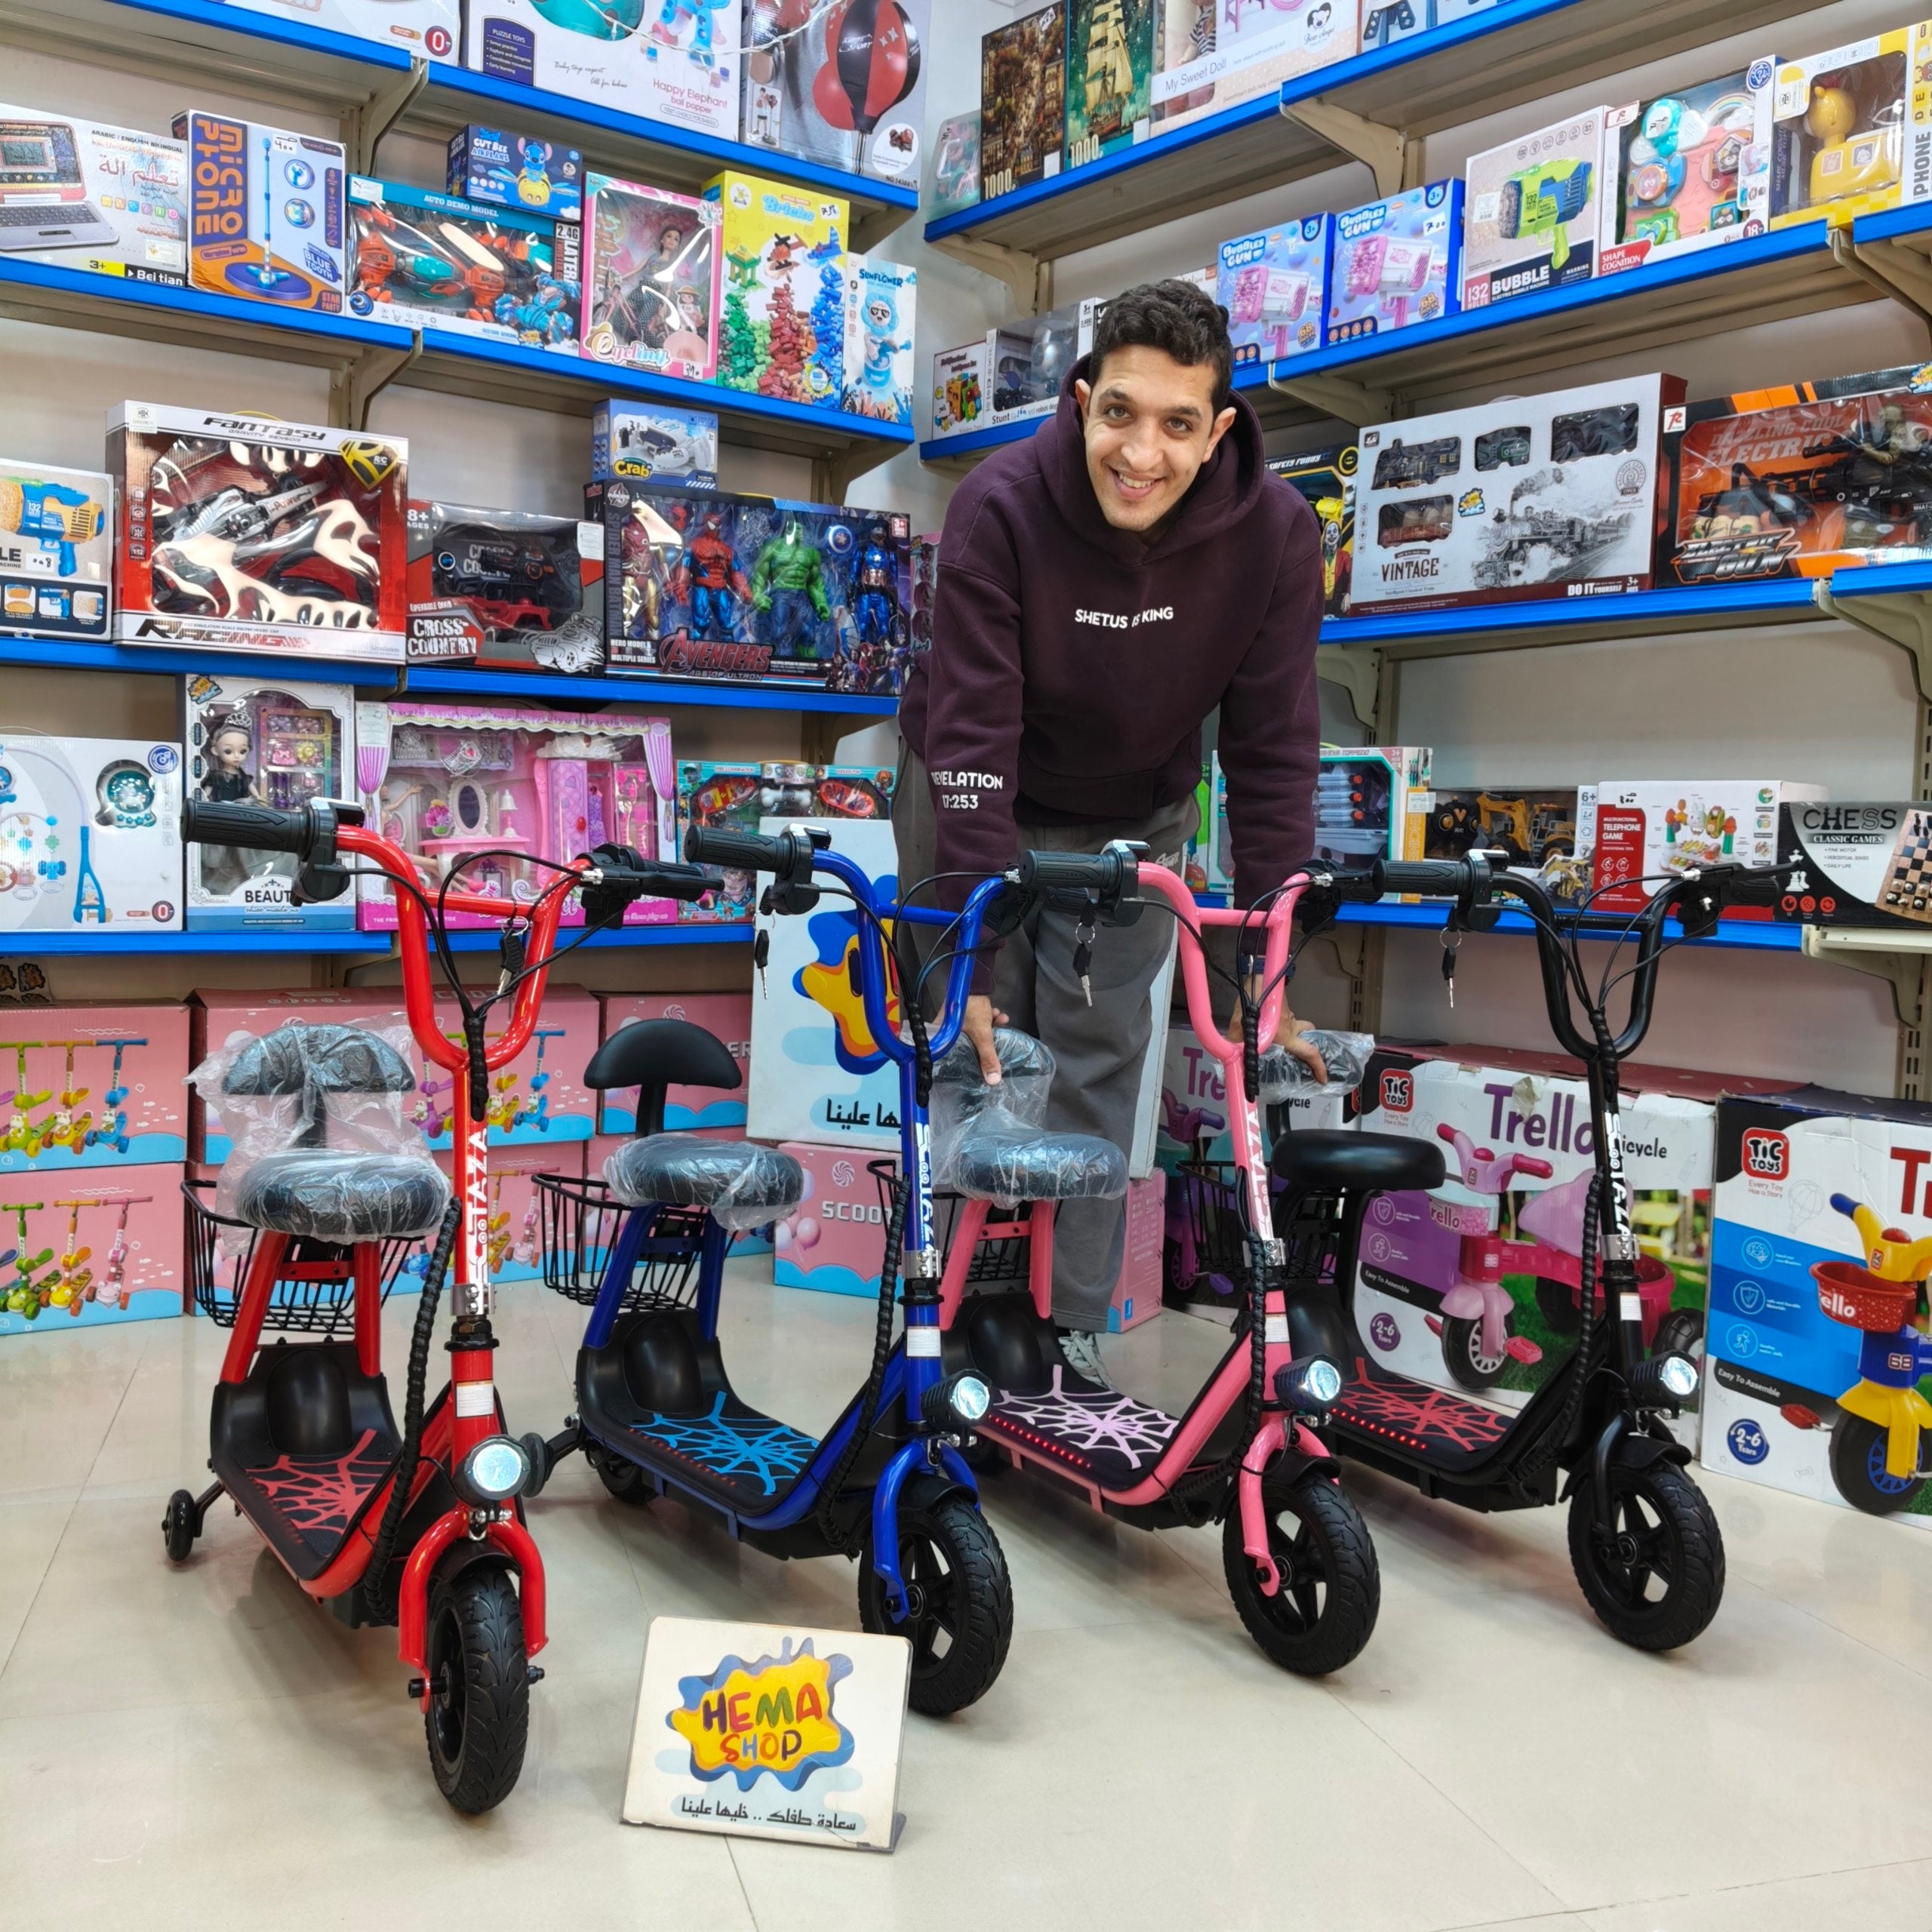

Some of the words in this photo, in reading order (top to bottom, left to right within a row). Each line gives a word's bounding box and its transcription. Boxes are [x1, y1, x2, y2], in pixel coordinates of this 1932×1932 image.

[493, 29, 510, 40] PUZZLE
[512, 34, 526, 43] TOYS
[1165, 78, 1179, 93] My
[1180, 66, 1208, 87] Sweet
[1210, 58, 1227, 75] Doll
[653, 78, 685, 100] Happy
[687, 88, 728, 109] Elephant
[671, 96, 683, 107] ball
[686, 101, 712, 115] popper
[91, 129, 115, 139] ARABIC
[121, 135, 149, 146] ENGLISH
[150, 141, 183, 153] BILINGUAL
[473, 137, 492, 149] CUT
[493, 141, 508, 153] BEE
[471, 147, 510, 163] AIRPLANE
[1913, 131, 1931, 196] PHONE
[423, 194, 445, 206] AUTO
[445, 196, 470, 211] DEMO
[471, 204, 500, 218] MODEL
[1430, 192, 1441, 202] 3+
[1526, 193, 1537, 204] 132
[1340, 207, 1386, 229] BUBBLES
[556, 225, 580, 240] 2.4G
[1306, 225, 1316, 234] 3+
[1345, 221, 1371, 238] GUN
[1223, 238, 1265, 257] BUBBLES
[1601, 249, 1626, 263] SHAPE
[90, 260, 106, 269] 3+
[304, 249, 332, 272] BLUE
[1227, 251, 1254, 267] GUN
[1601, 254, 1641, 272] COGNITION
[137, 269, 157, 281] Bei
[158, 271, 183, 287] tian
[305, 260, 334, 281] TOOTH
[859, 268, 904, 288] SUNFLOWER
[1565, 263, 1589, 275] WARNING
[1491, 264, 1550, 296] BUBBLE
[321, 292, 340, 303] STAR
[1468, 281, 1489, 303] 132
[321, 300, 340, 312] PARTY
[1035, 403, 1049, 414] robot
[992, 414, 1011, 425] Stunt
[228, 429, 265, 438] GRAVITY
[268, 434, 302, 442] SENSOR
[1709, 422, 1798, 447] DAZZLING
[373, 455, 388, 465] R/C
[614, 460, 651, 477] Crab
[28, 502, 41, 512] 132
[407, 509, 429, 521] 8+
[609, 511, 622, 549] SPIDER
[894, 518, 906, 528] 3+
[1681, 531, 1790, 559] ELECTRIC
[609, 552, 622, 575] MAN
[1381, 558, 1440, 582] VINTAGE
[1715, 545, 1795, 577] GUN
[1567, 584, 1583, 596] DO
[1584, 583, 1595, 595] IT
[1594, 584, 1623, 593] YOURSELF
[1627, 576, 1639, 586] 3+
[609, 579, 623, 635] BATMAN
[1075, 608, 1128, 629] SHETUS
[1132, 614, 1140, 628] IS
[1141, 606, 1174, 624] KING
[135, 618, 289, 648] RACING
[408, 637, 477, 656] COUNTRY
[611, 639, 626, 648] HERO
[660, 628, 774, 675] AVENGERS
[611, 654, 636, 663] MULTIPLE
[637, 655, 656, 664] SERIES
[1581, 791, 1597, 801] 6+
[1803, 806, 1897, 830] CHESS
[1602, 832, 1623, 841] GAME
[1603, 823, 1641, 832] TELEPHONE
[1813, 835, 1850, 844] CLASSIC
[1850, 835, 1884, 844] GAMES
[1386, 1094, 1407, 1106] TOYS
[826, 1098, 870, 1130] علينا
[1384, 1112, 1399, 1121] Every
[1399, 1114, 1409, 1123] Toy
[1484, 1083, 1595, 1155] Trello
[1750, 1158, 1781, 1173] TOYS
[1748, 1187, 1760, 1195] Has
[1767, 1189, 1783, 1199] Story
[1749, 1179, 1771, 1190] Every
[1772, 1183, 1784, 1193] Toy
[1364, 1269, 1377, 1281] Easy
[1377, 1274, 1385, 1283] To
[1384, 1277, 1411, 1294] Assemble
[1376, 1320, 1395, 1337] 2-6
[1377, 1334, 1392, 1344] Years
[1887, 1352, 1914, 1371] 68
[1718, 1367, 1735, 1383] Easy
[1735, 1372, 1746, 1384] To
[1746, 1376, 1781, 1398] Assemble
[1735, 1428, 1761, 1447] 2-6
[1737, 1444, 1757, 1457] Years
[703, 1682, 823, 1734] HEMA
[719, 1729, 802, 1763] SHOP
[681, 1797, 712, 1818] علينا
[716, 1800, 749, 1822] خليها
[766, 1808, 813, 1826] طفلك
[817, 1813, 856, 1831] سعادة
